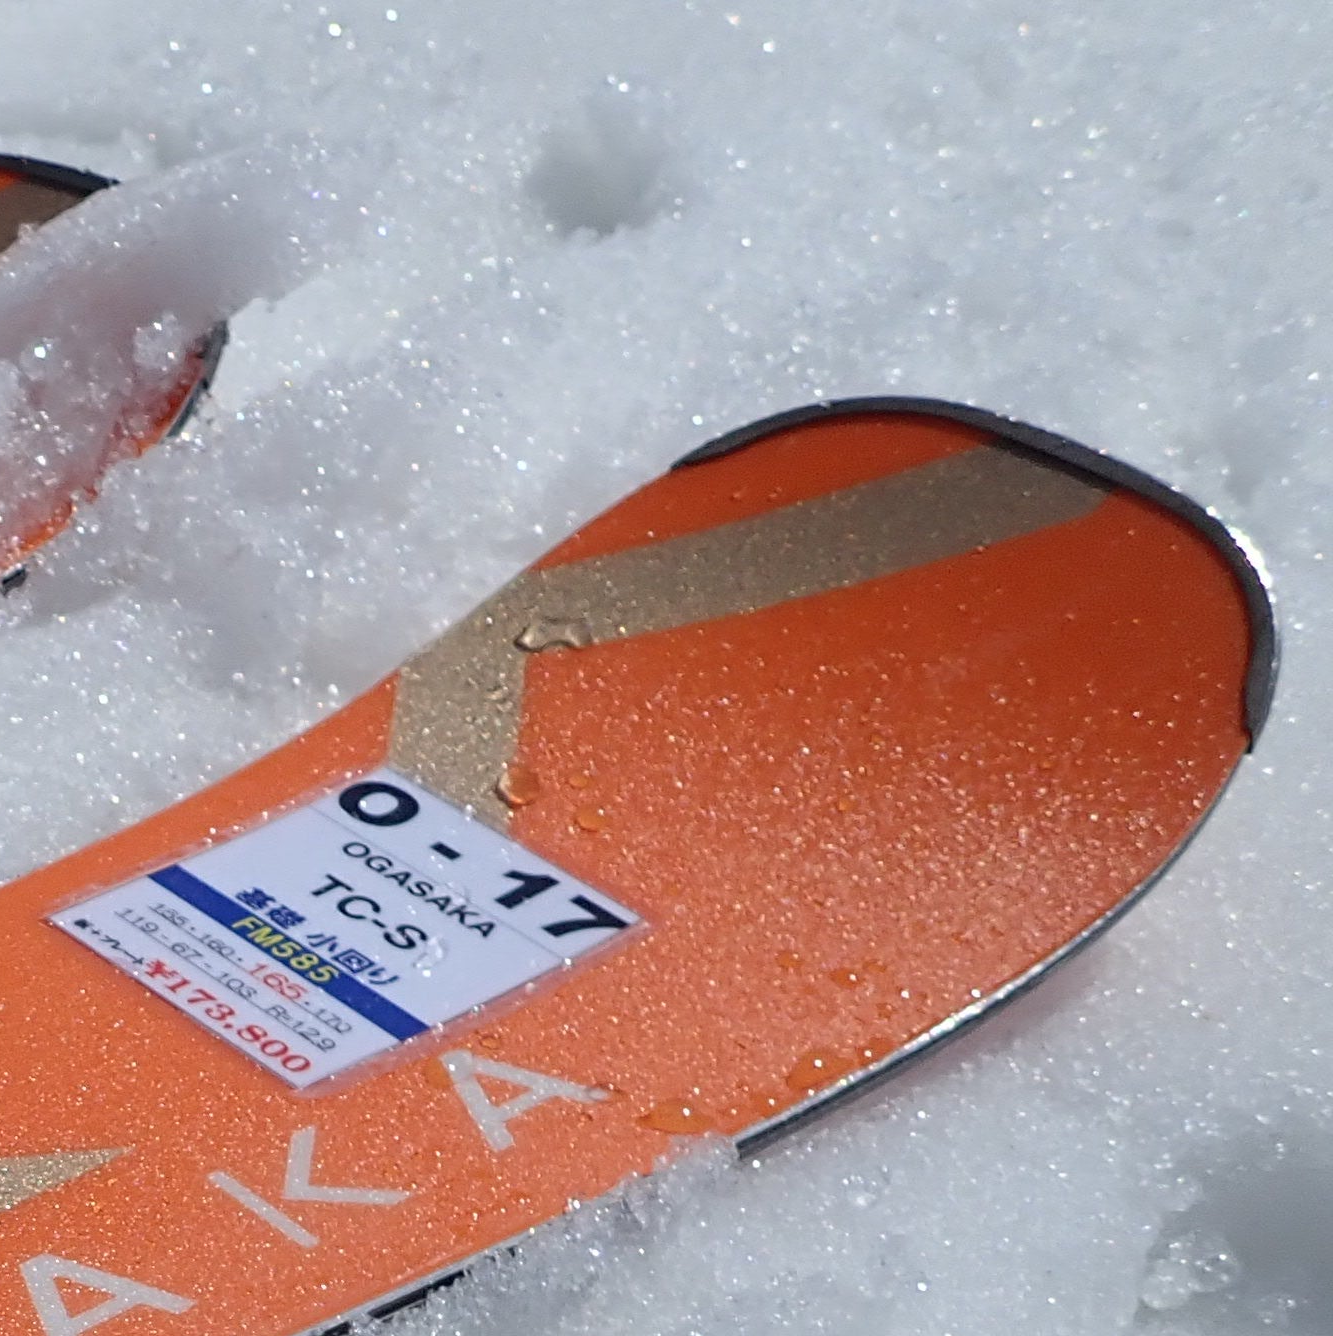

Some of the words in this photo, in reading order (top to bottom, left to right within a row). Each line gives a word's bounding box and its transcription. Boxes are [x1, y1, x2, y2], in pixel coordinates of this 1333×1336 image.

[311, 874, 429, 952] TC-S
[341, 840, 497, 939] OGASAKA
[233, 915, 340, 984] FM585
